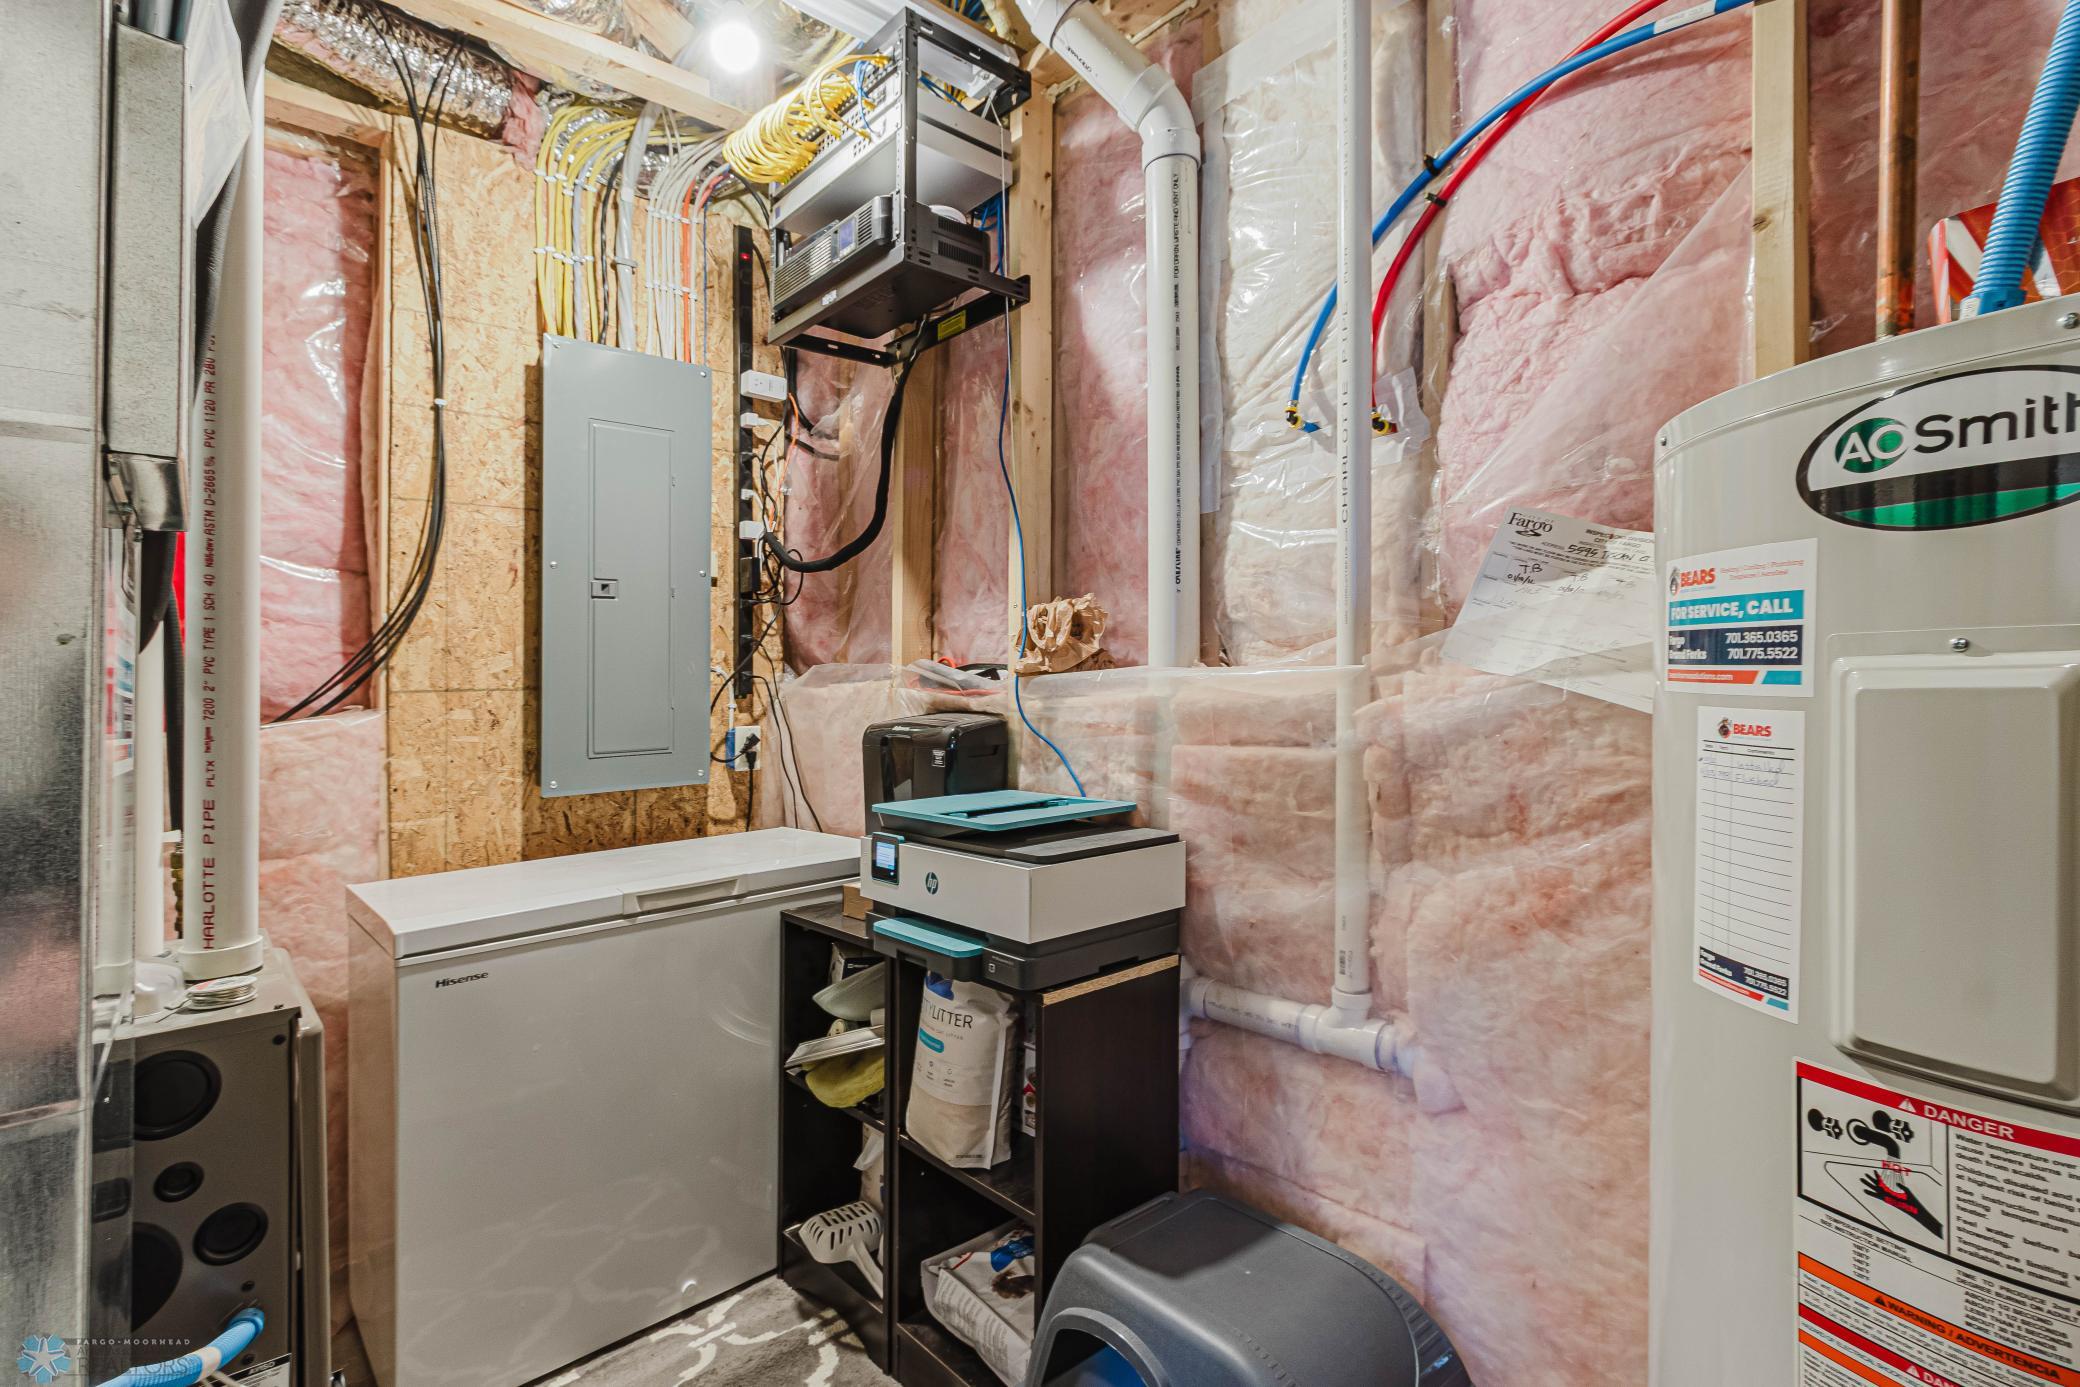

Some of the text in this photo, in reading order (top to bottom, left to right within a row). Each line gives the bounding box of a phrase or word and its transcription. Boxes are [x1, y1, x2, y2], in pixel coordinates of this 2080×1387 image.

[204, 381, 216, 394] PR
[204, 400, 216, 422] 1120
[204, 428, 216, 448] PVC
[204, 510, 216, 536] ASTM
[1507, 512, 1553, 532] Fargo
[203, 574, 215, 586] 40
[1680, 568, 1716, 587] BEARS
[203, 593, 215, 610] SCH
[1670, 598, 1794, 620] FOR SERVICE, CALL
[203, 627, 215, 650] TYPE
[1725, 630, 1798, 644] 701.365.0365
[1727, 647, 1798, 660] 701.775.5522
[203, 656, 215, 674] PVC
[203, 698, 215, 720] 7200
[1734, 724, 1772, 737] BEARS
[205, 760, 215, 788] PLTX
[203, 799, 215, 844] PIPE
[926, 872, 938, 894] hp
[435, 972, 488, 988] Hisense
[1923, 1104, 2015, 1140] DANGER
[1956, 1134, 2077, 1170] Water temperature over
[1986, 1160, 2009, 1172] from
[1990, 1154, 2024, 1166] severe
[2030, 1162, 2062, 1176] burns
[1956, 1164, 2073, 1201] Children, disabled and
[2044, 1198, 2075, 1213] being
[2001, 1209, 2069, 1234] temperature
[2023, 1237, 2059, 1253] before
[1887, 1301, 1946, 1334] WARNING
[1956, 1334, 2060, 1380] ADVERTENCIA
